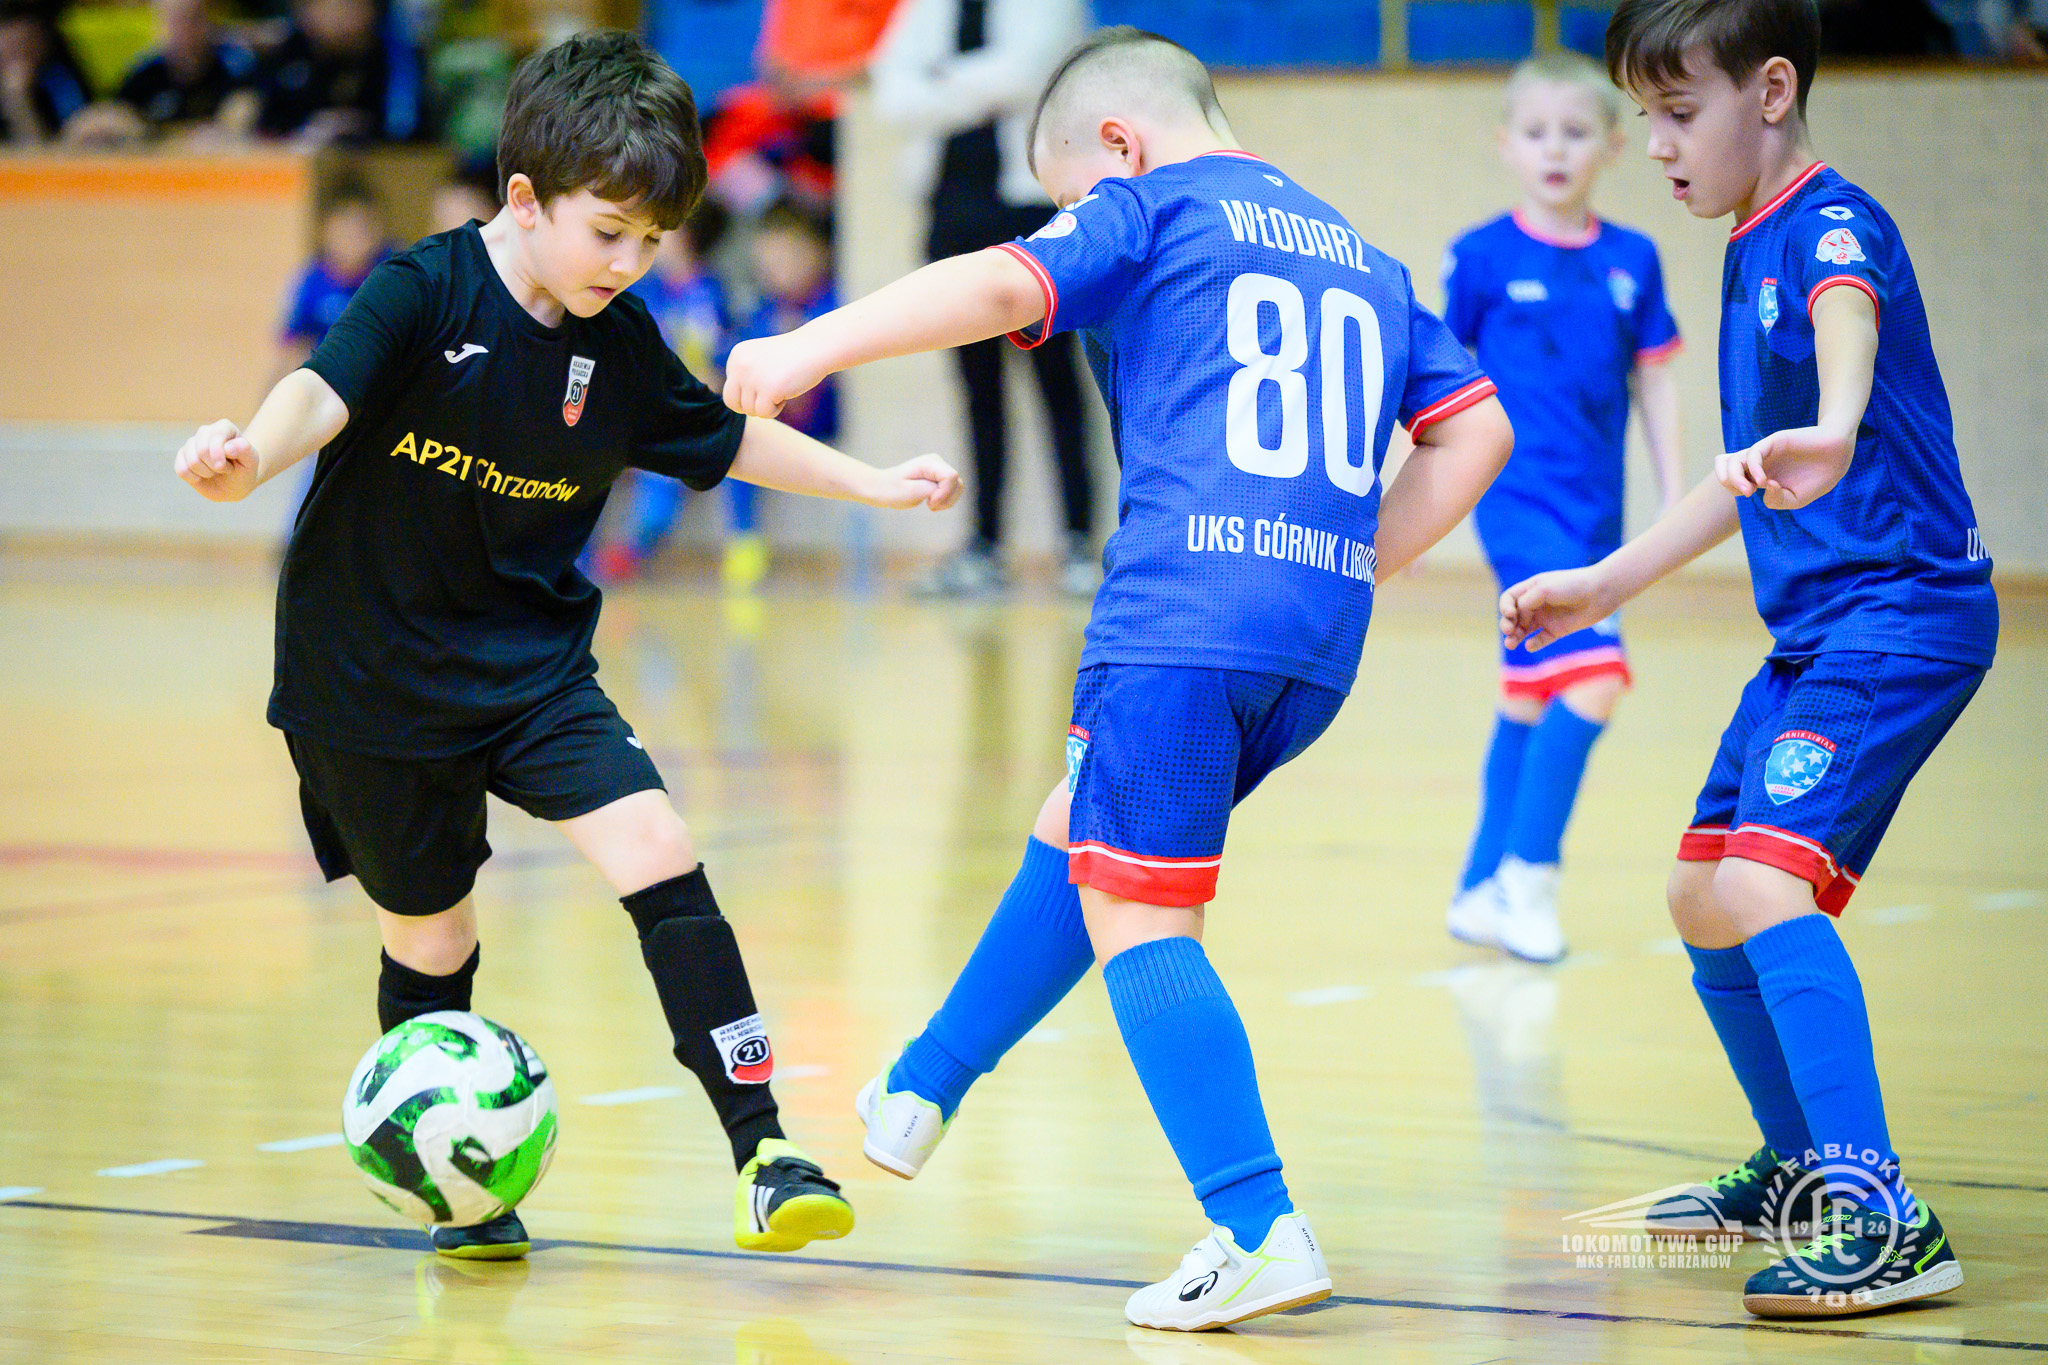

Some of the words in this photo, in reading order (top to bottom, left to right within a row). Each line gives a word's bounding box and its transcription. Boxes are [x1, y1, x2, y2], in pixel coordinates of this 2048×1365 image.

[1218, 199, 1371, 273] WŁODARZ
[572, 385, 581, 401] 21
[1226, 272, 1385, 497] 80
[390, 431, 474, 481] AP21
[475, 458, 580, 502] Chrzanów
[1187, 514, 1245, 553] UKS
[1254, 512, 1339, 573] GÓRNIK
[1341, 537, 1378, 592] LIBIĄ
[741, 1041, 764, 1061] 21
